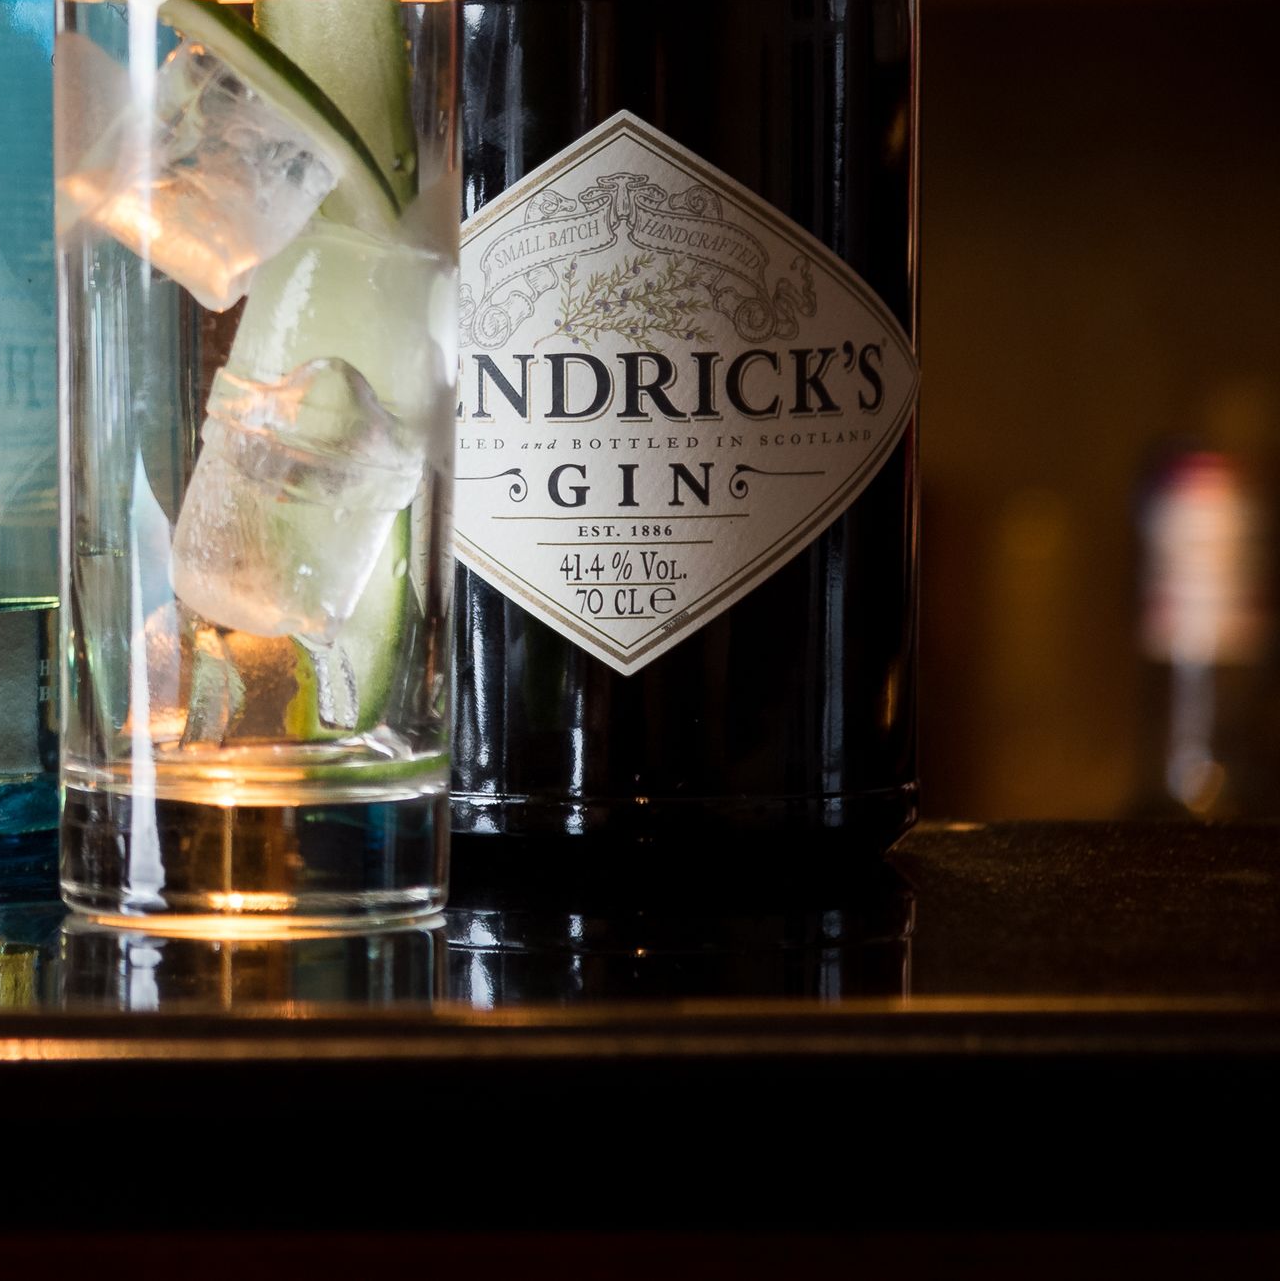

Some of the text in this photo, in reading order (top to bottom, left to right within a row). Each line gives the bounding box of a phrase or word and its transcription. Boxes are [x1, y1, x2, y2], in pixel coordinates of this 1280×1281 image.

[494, 219, 762, 269] SMALL BATCH HANDCRAFTED
[521, 439, 557, 450] and
[573, 437, 699, 449] BOTTLED
[716, 435, 743, 448] IN
[760, 429, 872, 447] SCOTLAND
[547, 463, 715, 508] GIN
[578, 524, 673, 537] EST. 1886
[612, 550, 633, 581] %
[576, 587, 604, 614] 70
[614, 588, 644, 615] CL
